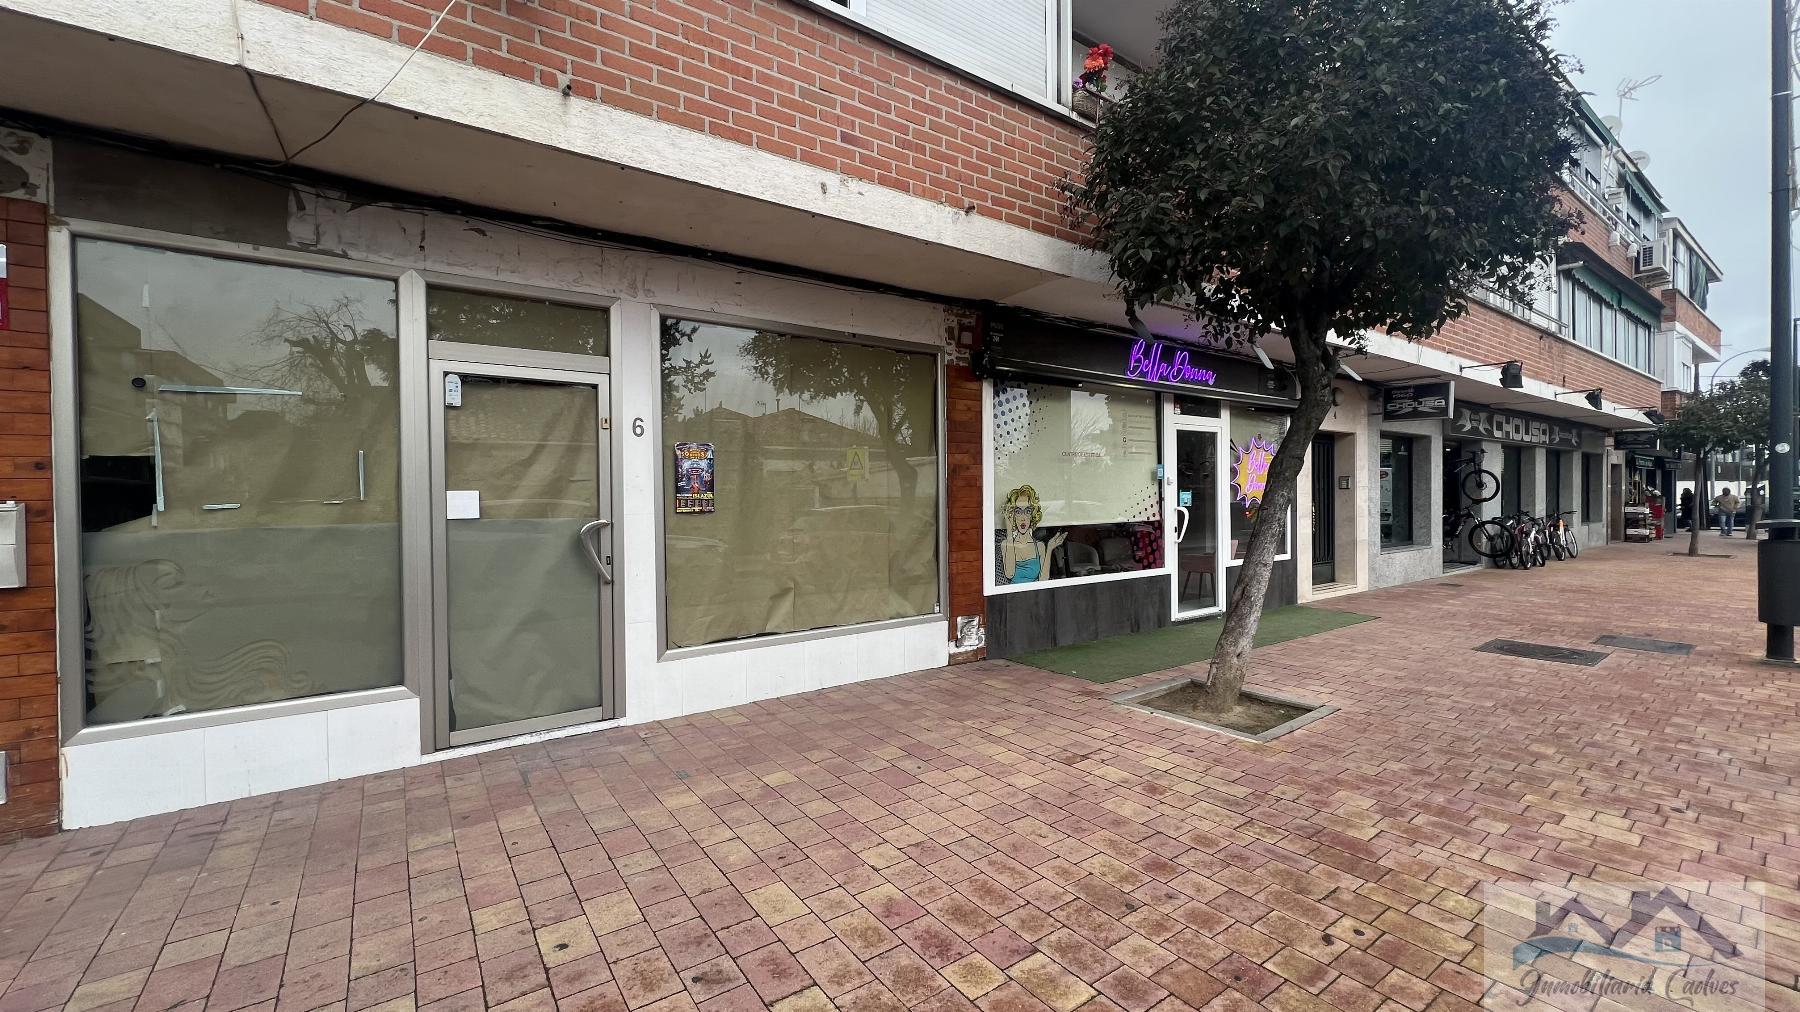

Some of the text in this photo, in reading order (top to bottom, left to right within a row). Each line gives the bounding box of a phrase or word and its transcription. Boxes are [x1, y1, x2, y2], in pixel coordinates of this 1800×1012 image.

[1127, 338, 1217, 386] Bella Donna
[1386, 399, 1446, 410] CHOUSA
[632, 417, 645, 438] 6
[1493, 414, 1550, 445] CHOUSA
